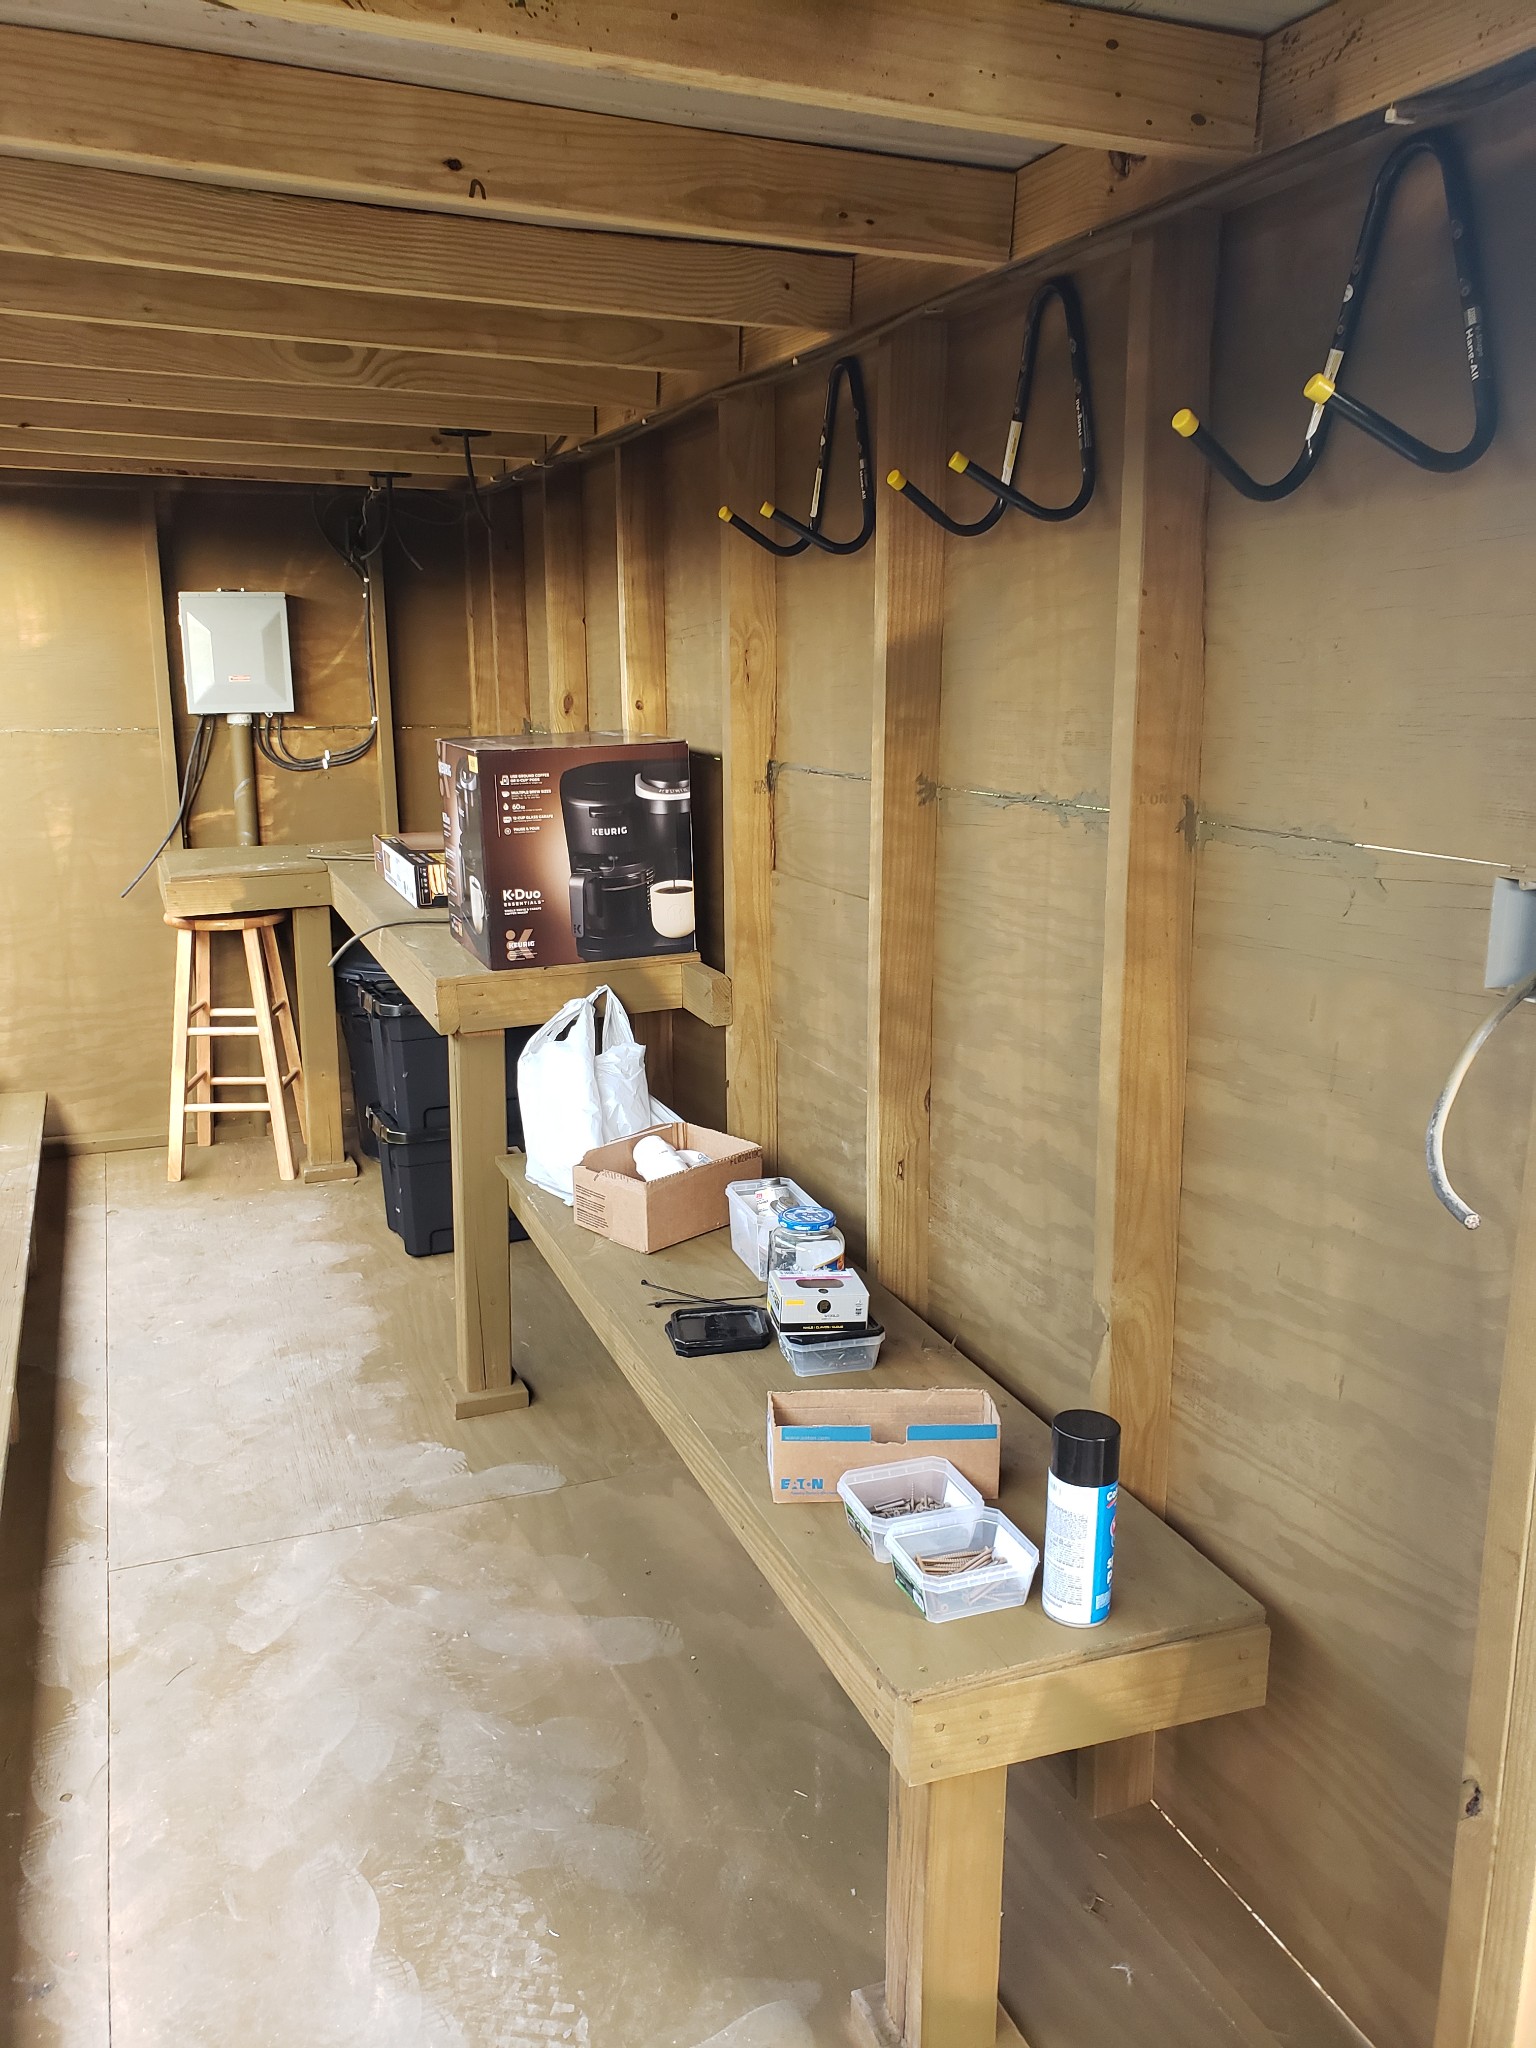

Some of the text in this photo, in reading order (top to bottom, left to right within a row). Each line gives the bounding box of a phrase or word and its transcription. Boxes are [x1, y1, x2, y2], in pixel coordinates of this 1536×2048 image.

[1465, 327, 1480, 381] Hang-All
[591, 826, 628, 836] KEURIG
[508, 941, 535, 949] KEURIG
[781, 1478, 824, 1490] EATON
